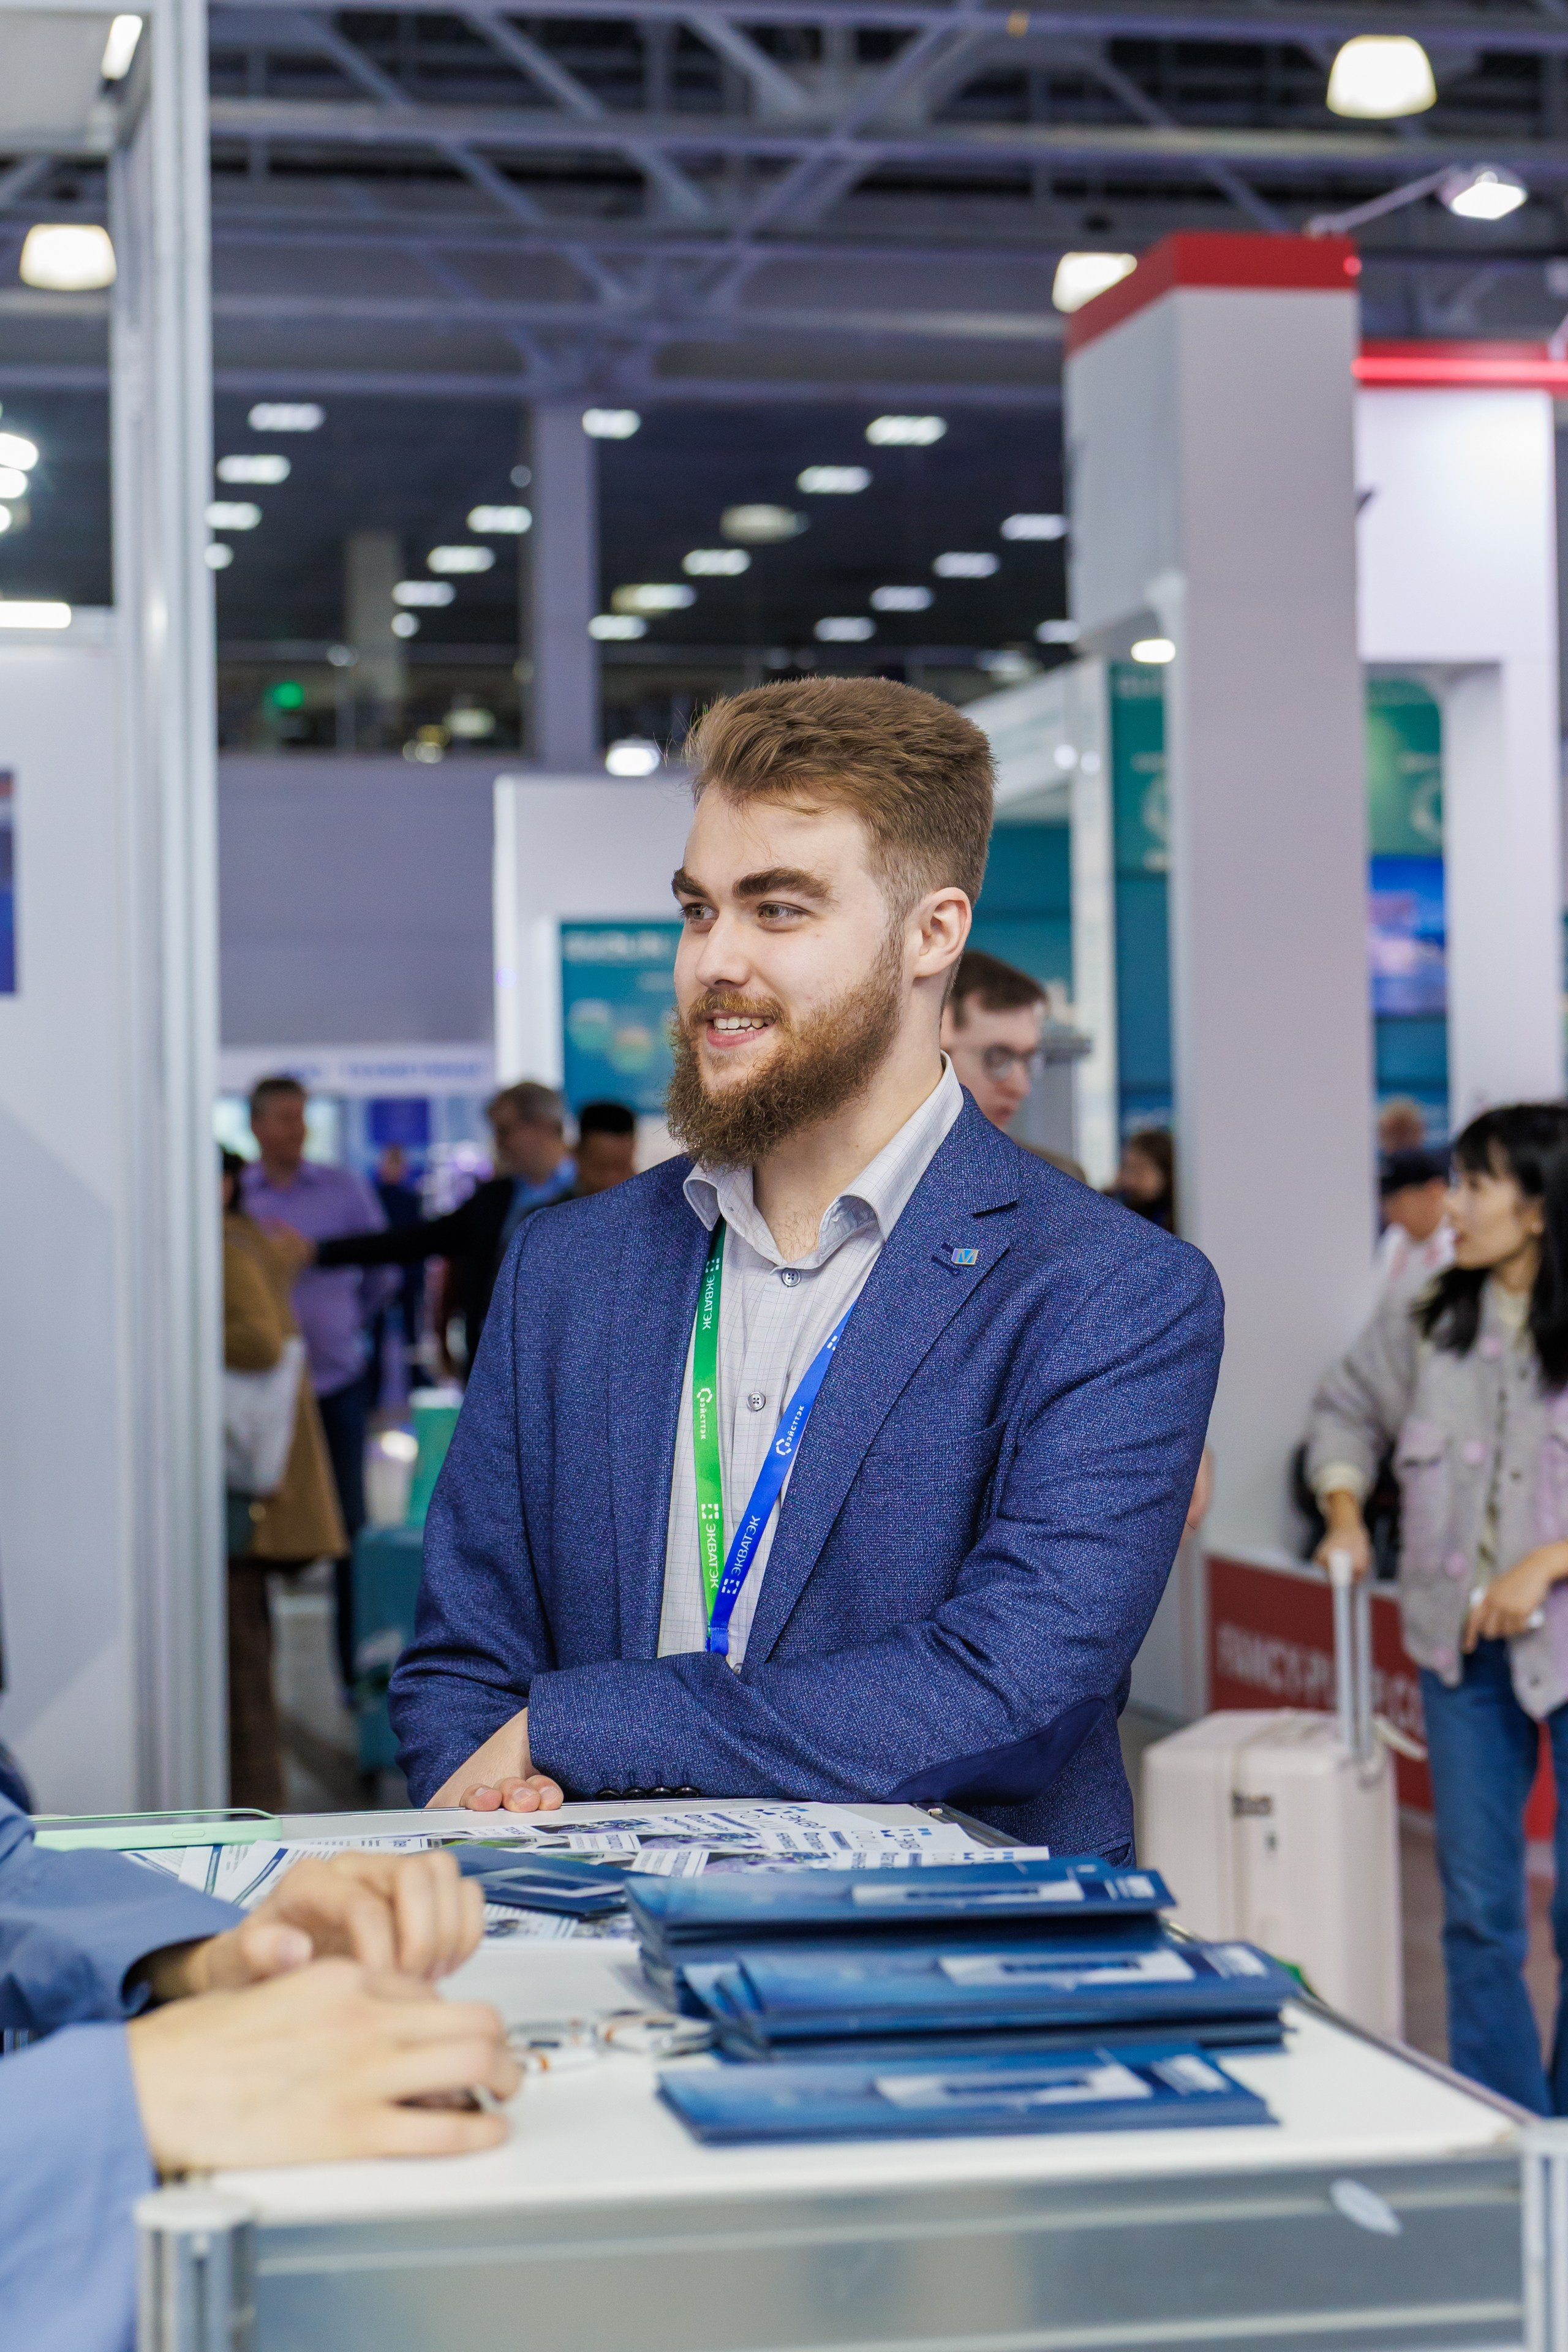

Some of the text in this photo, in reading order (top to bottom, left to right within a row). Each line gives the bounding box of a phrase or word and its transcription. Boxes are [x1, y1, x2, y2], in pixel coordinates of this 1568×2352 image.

[703, 1275, 715, 1330] ЭКВАТЭК
[785, 1405, 805, 1447] ВЭЙСТТЭК
[706, 1523, 719, 1588] ЭКВАТЭК
[731, 1515, 761, 1576] ЭКВАТЭК
